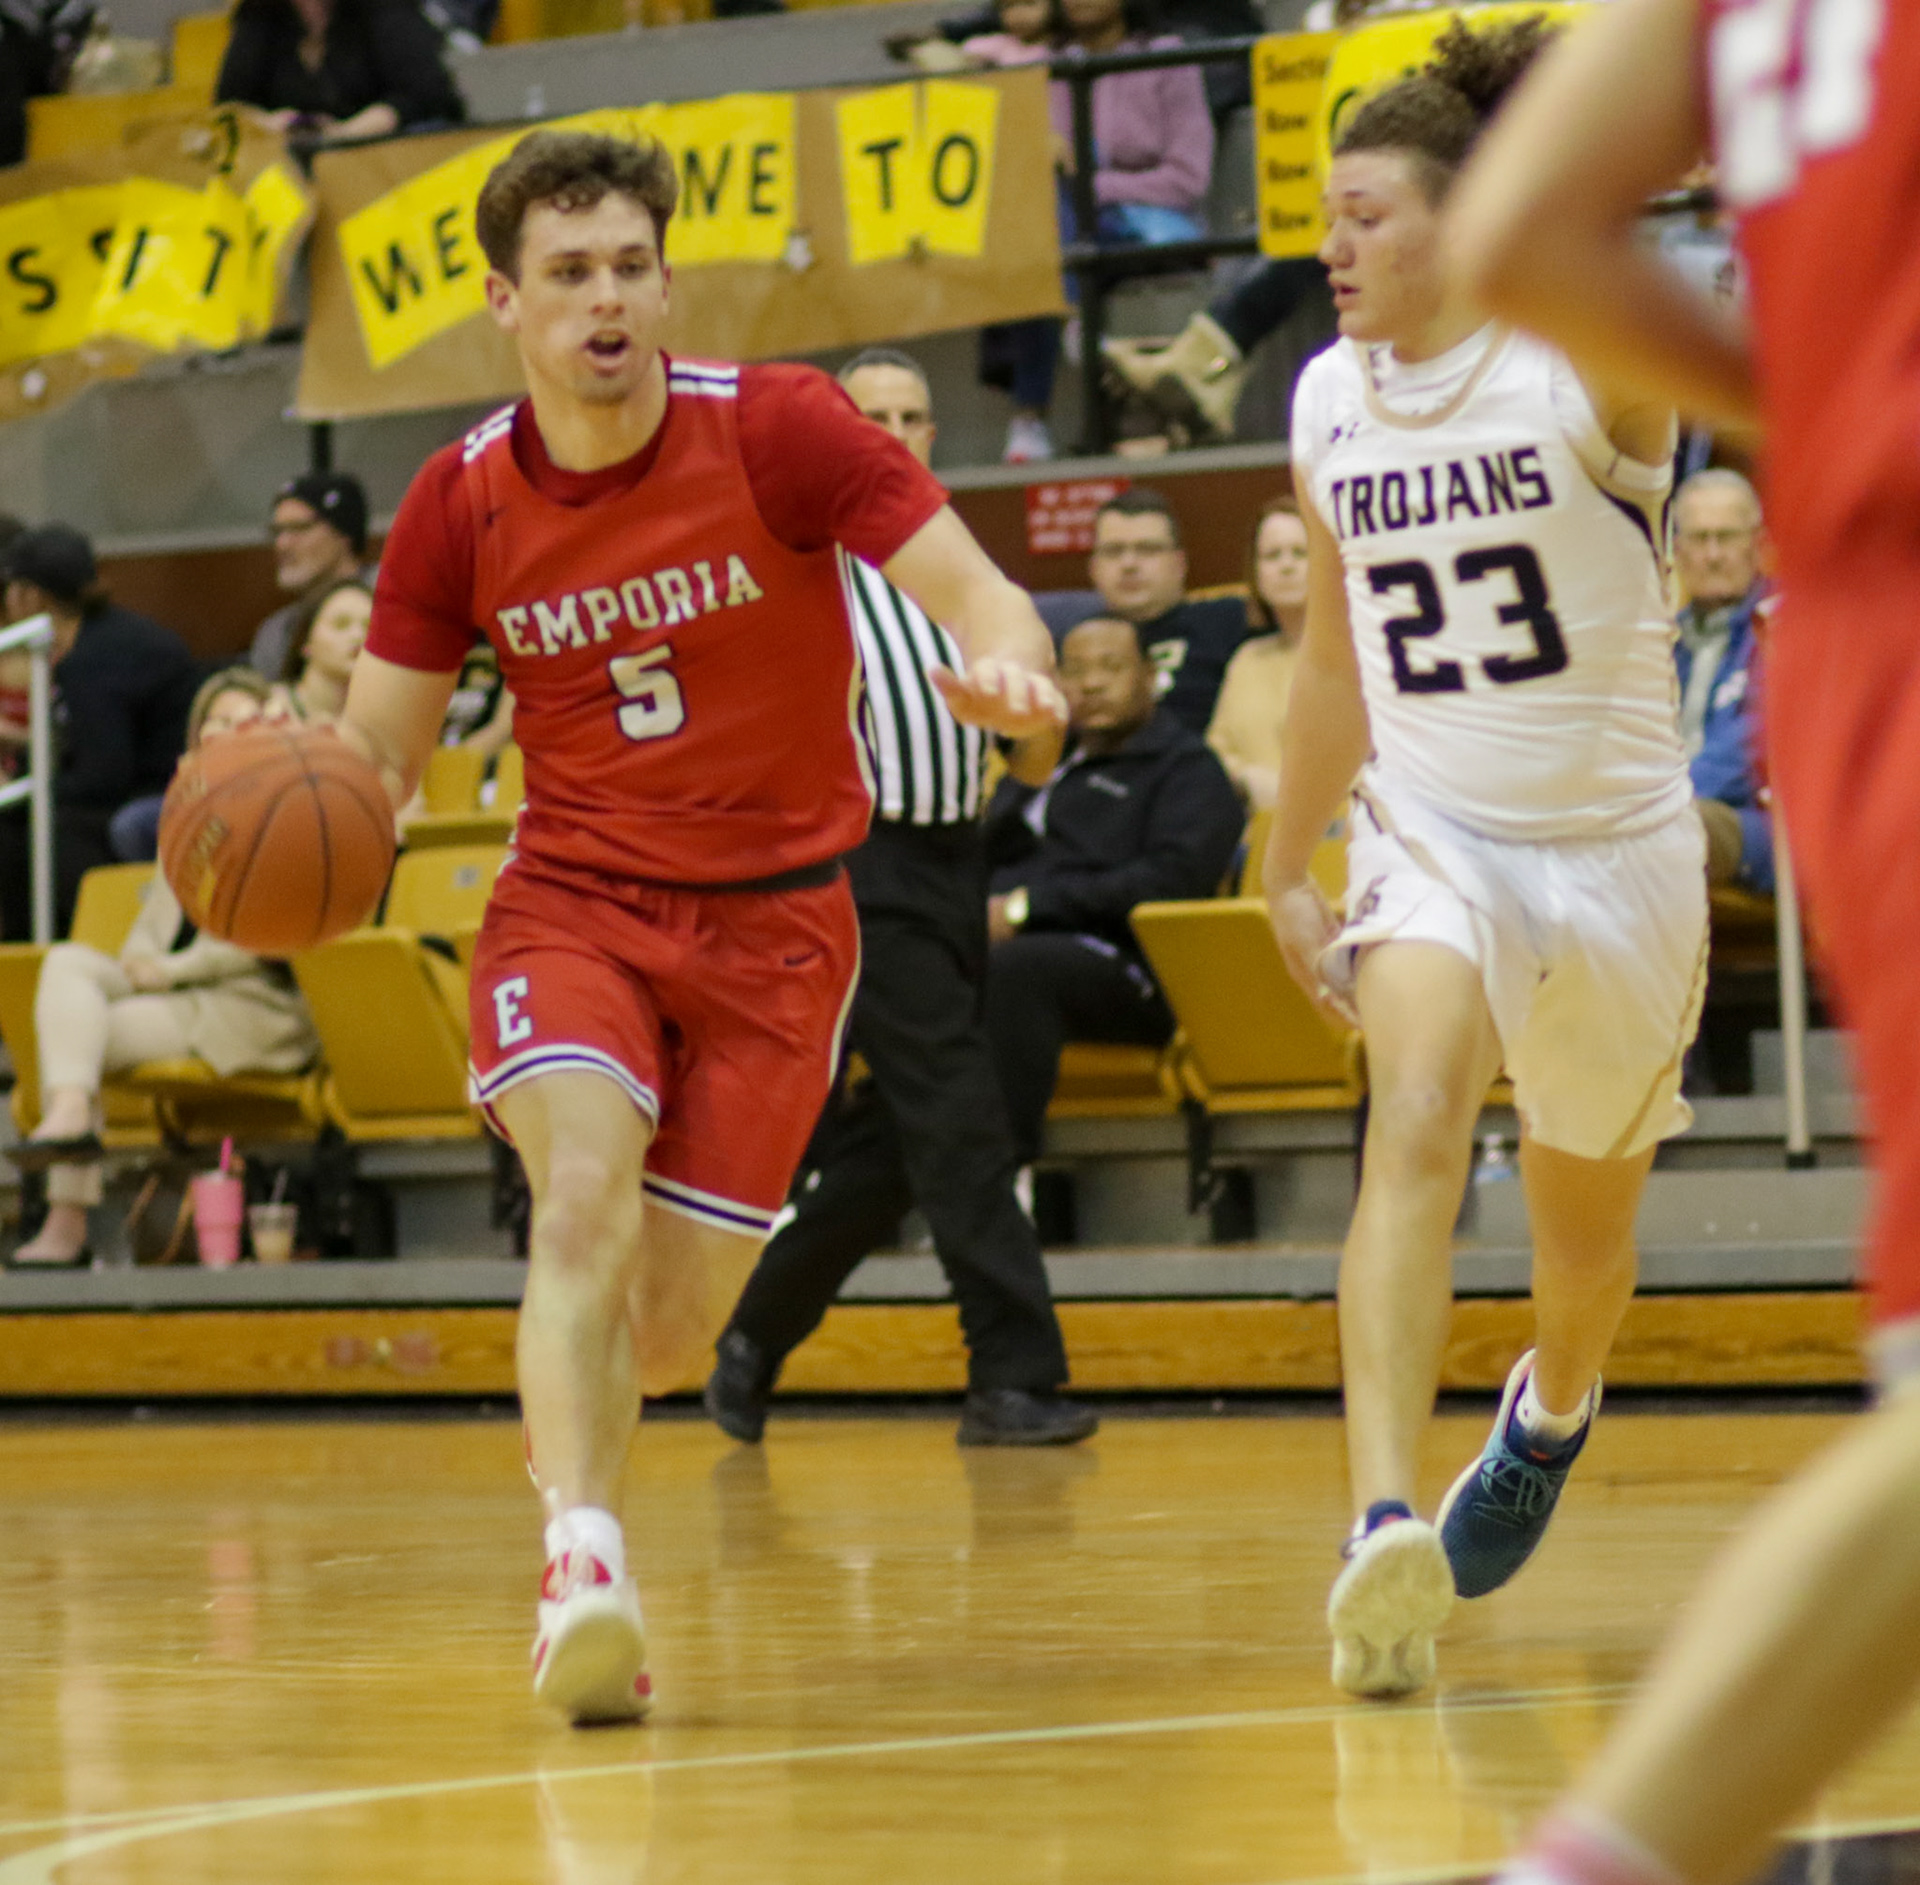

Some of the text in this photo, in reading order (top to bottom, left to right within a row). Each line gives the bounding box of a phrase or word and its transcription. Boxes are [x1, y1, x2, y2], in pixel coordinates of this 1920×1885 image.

[860, 134, 979, 212] TO
[1331, 446, 1553, 541] TROJANS
[497, 554, 764, 656] EMPORIA
[1366, 544, 1569, 694] 23
[608, 645, 686, 742] 5
[491, 976, 532, 1048] E
